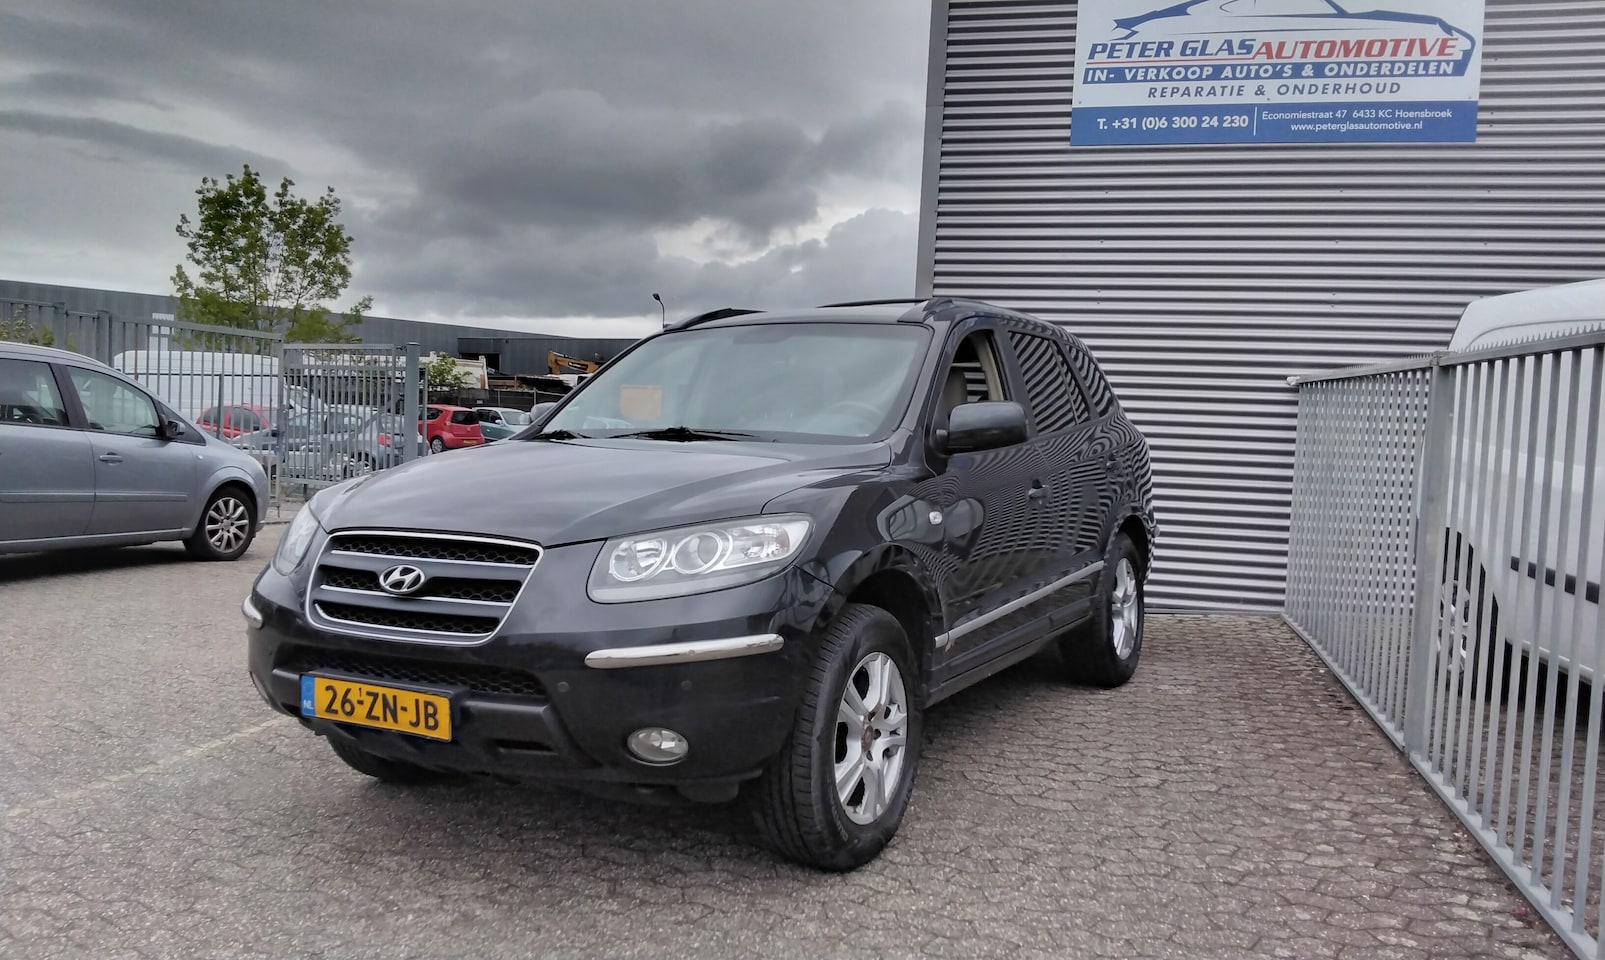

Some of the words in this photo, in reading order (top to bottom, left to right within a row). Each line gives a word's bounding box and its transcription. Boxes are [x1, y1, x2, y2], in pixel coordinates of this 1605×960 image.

[1088, 40, 1175, 60] PETER
[1087, 69, 1115, 82] IN-
[1124, 66, 1213, 81] VERKOOP
[1220, 64, 1293, 79] AUTO'S
[1301, 63, 1314, 77] &
[1324, 61, 1454, 77] ONDERDELEN
[1147, 84, 1246, 99] REPARATIE
[1254, 84, 1266, 97] &
[1276, 82, 1401, 96] ONDERHOUD
[1097, 118, 1108, 130] T.
[1112, 117, 1137, 130] +31
[1141, 116, 1168, 131] (0)6
[1172, 116, 1198, 129] 300
[1201, 115, 1219, 128] 24
[1222, 115, 1249, 128] 230
[1262, 110, 1333, 121] Economiestraat
[1335, 109, 1348, 119] 47
[1352, 109, 1376, 119] 6433
[1378, 109, 1393, 118] KC
[1395, 108, 1453, 119] Hoensbroek
[1290, 120, 1423, 133] www.peterglasautomotive.nl
[303, 700, 315, 711] NL
[324, 684, 440, 731] 26-ZN-JB
